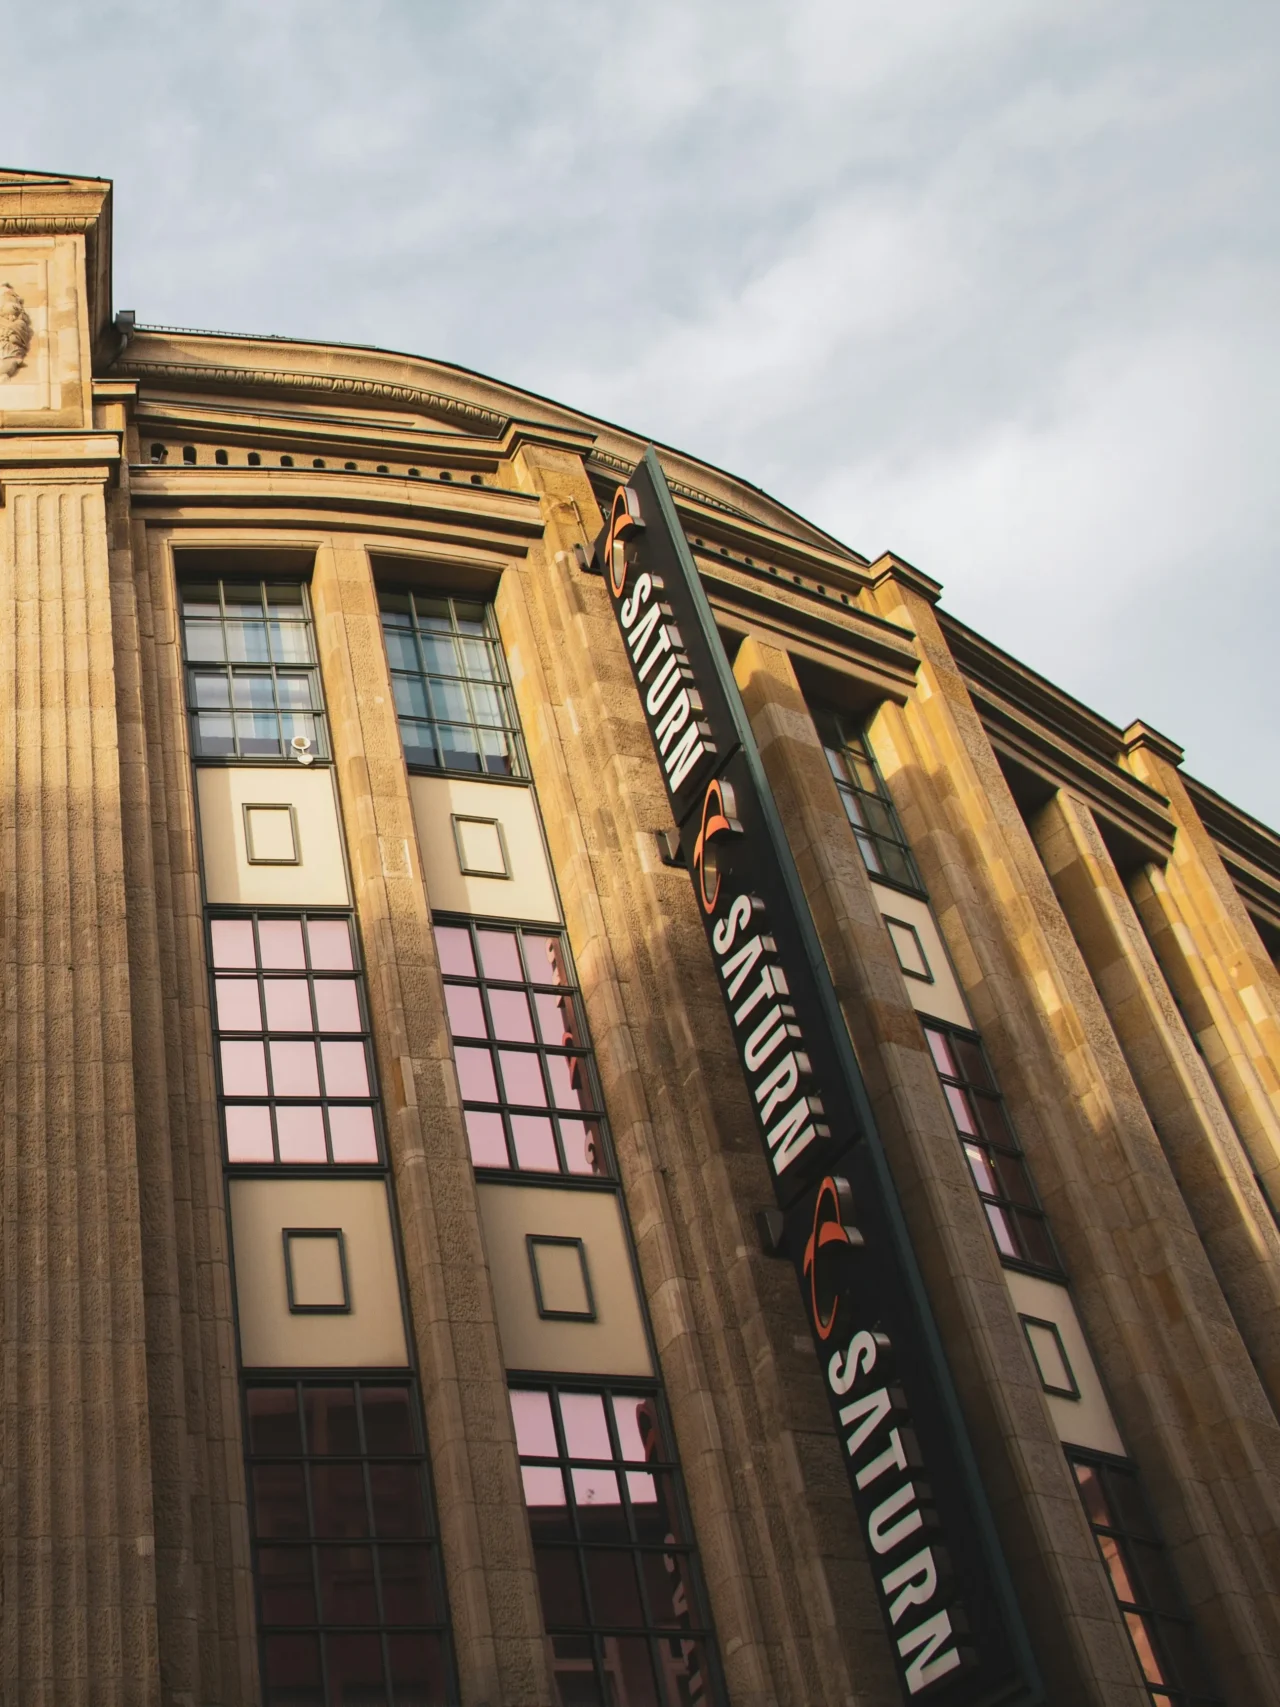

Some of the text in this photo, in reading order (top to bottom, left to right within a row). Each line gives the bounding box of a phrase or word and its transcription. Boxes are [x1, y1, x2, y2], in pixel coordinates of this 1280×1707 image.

[620, 572, 704, 794] SATURN
[712, 894, 816, 1176] SATURN
[828, 1330, 961, 1695] SATURN
